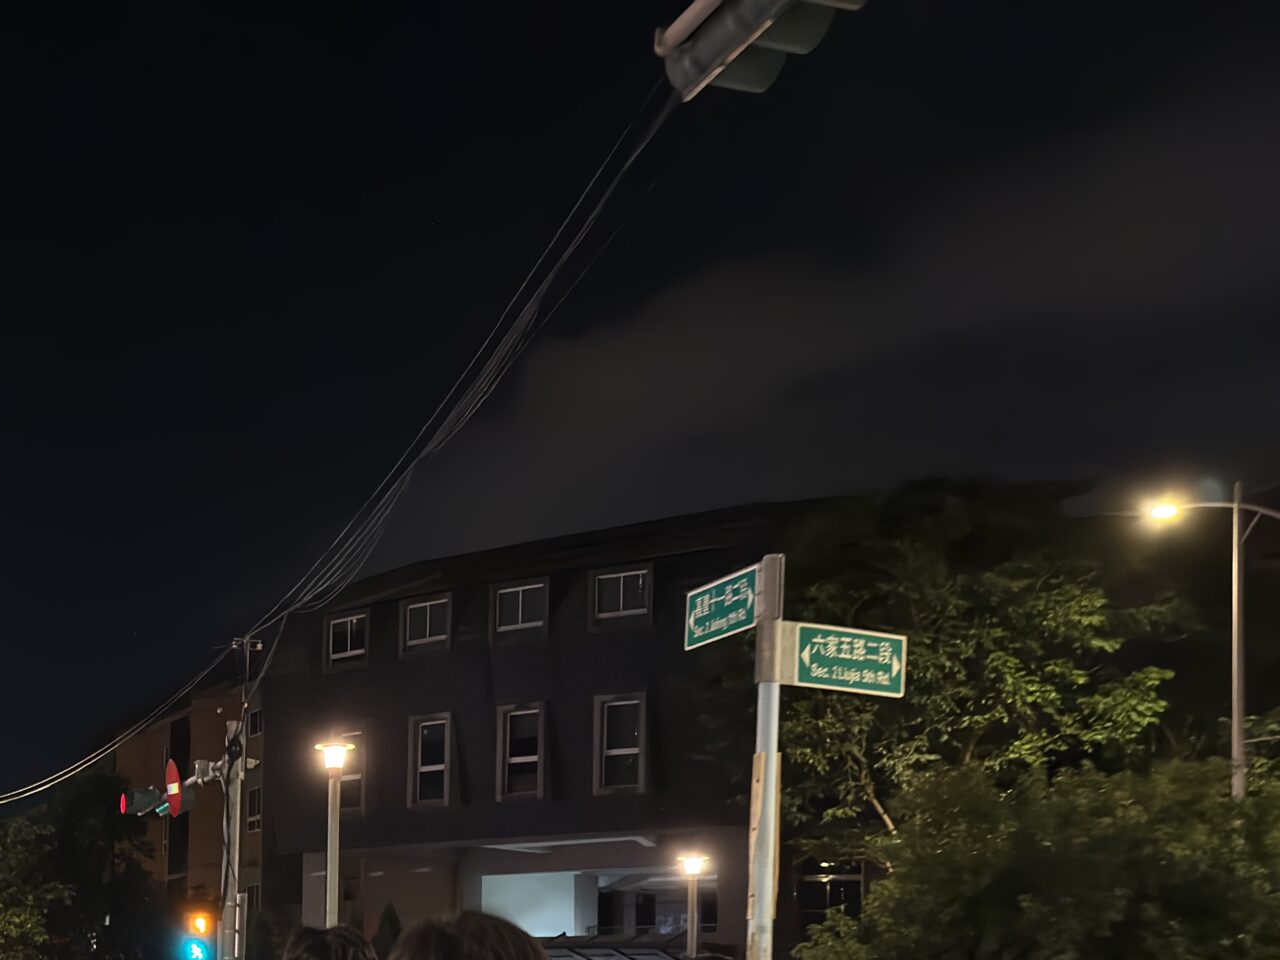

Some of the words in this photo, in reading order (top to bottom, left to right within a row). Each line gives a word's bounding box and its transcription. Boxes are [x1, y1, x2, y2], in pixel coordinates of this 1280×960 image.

[811, 634, 893, 665] 六家五路二段
